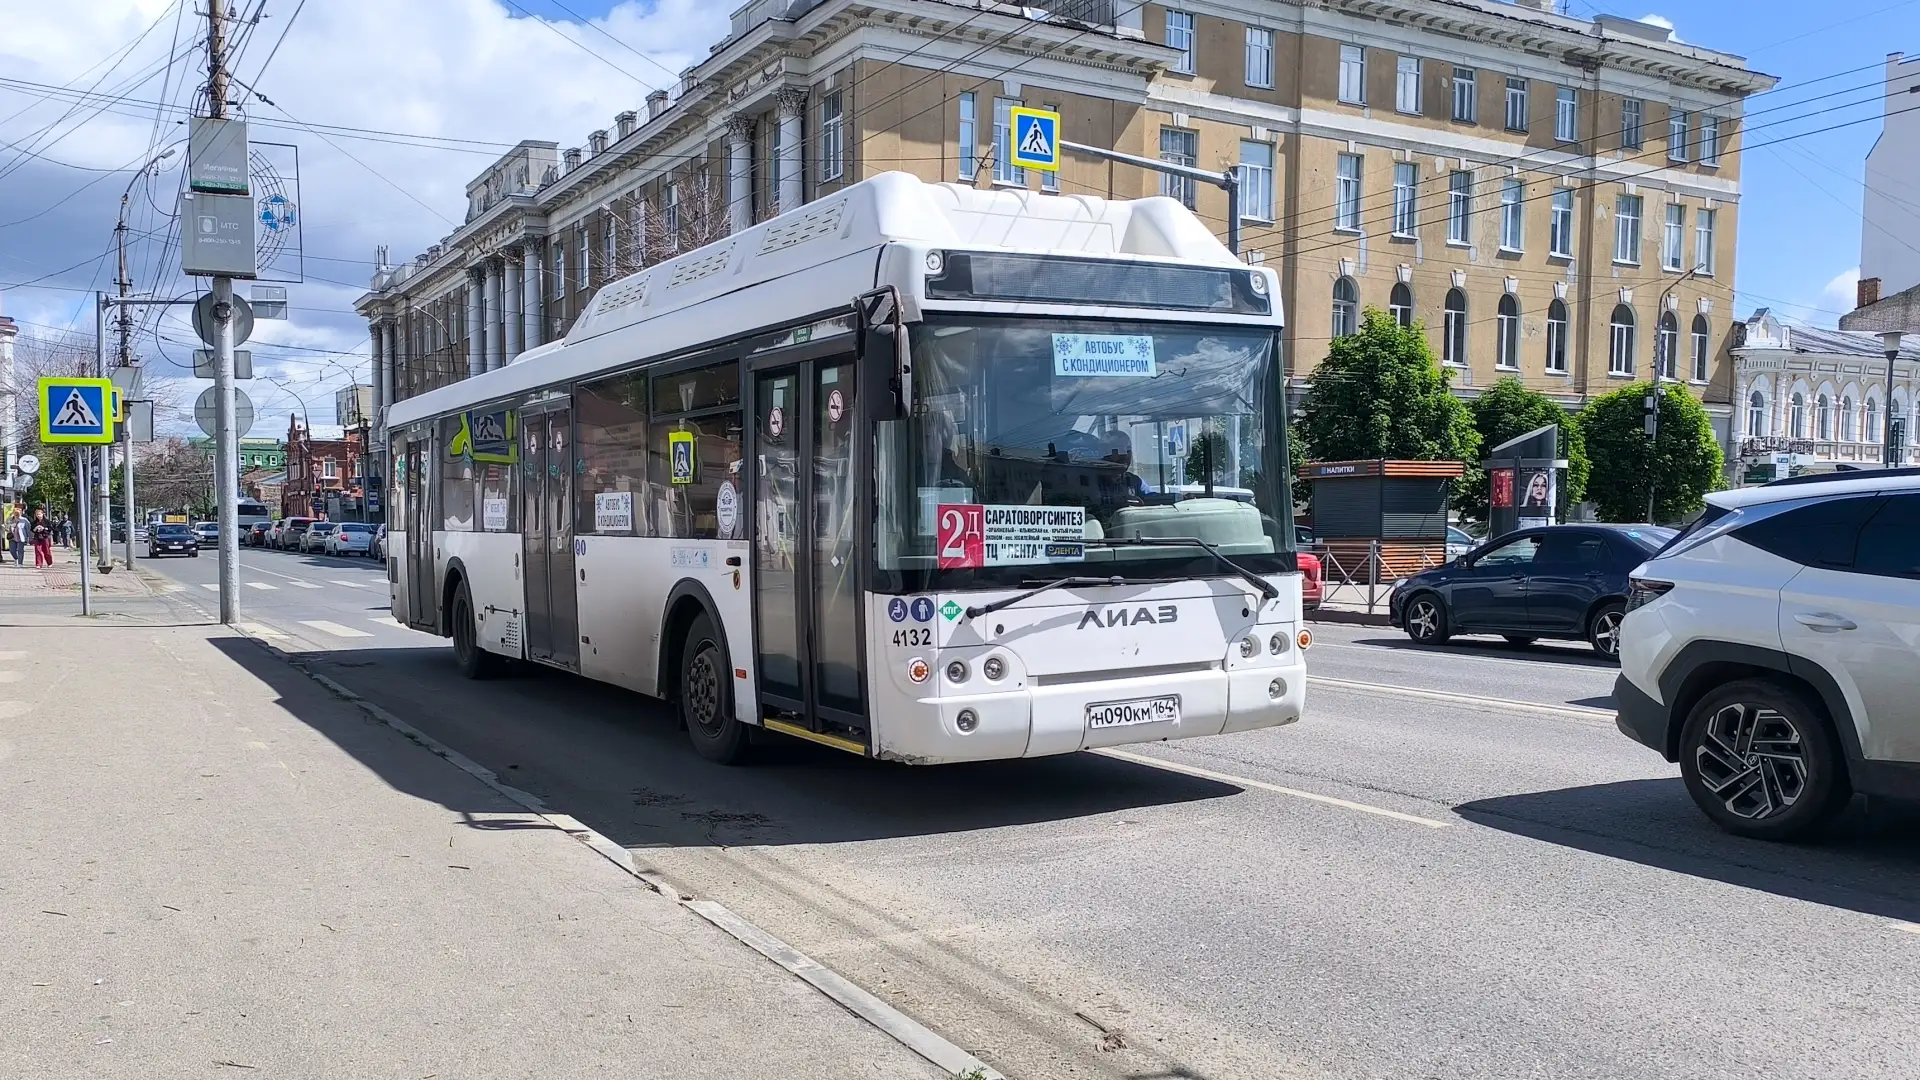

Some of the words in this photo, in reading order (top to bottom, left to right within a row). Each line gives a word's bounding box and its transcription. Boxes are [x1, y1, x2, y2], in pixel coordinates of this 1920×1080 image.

[1085, 340, 1124, 354] АВТОБУС
[1062, 358, 1068, 372] С
[1070, 358, 1149, 373] КОНДИЦИОНЕРОМ
[1326, 466, 1354, 474] НАПИТКИ
[986, 510, 1083, 526] САРАТОВОРГСИНТЕЗ
[986, 544, 998, 560] ТЦ
[942, 606, 958, 614] КПГ
[1076, 605, 1178, 630] ЛИАЗ
[892, 628, 932, 647] 4132
[1095, 706, 1150, 725] Н090КМ
[1152, 700, 1173, 714] 164
